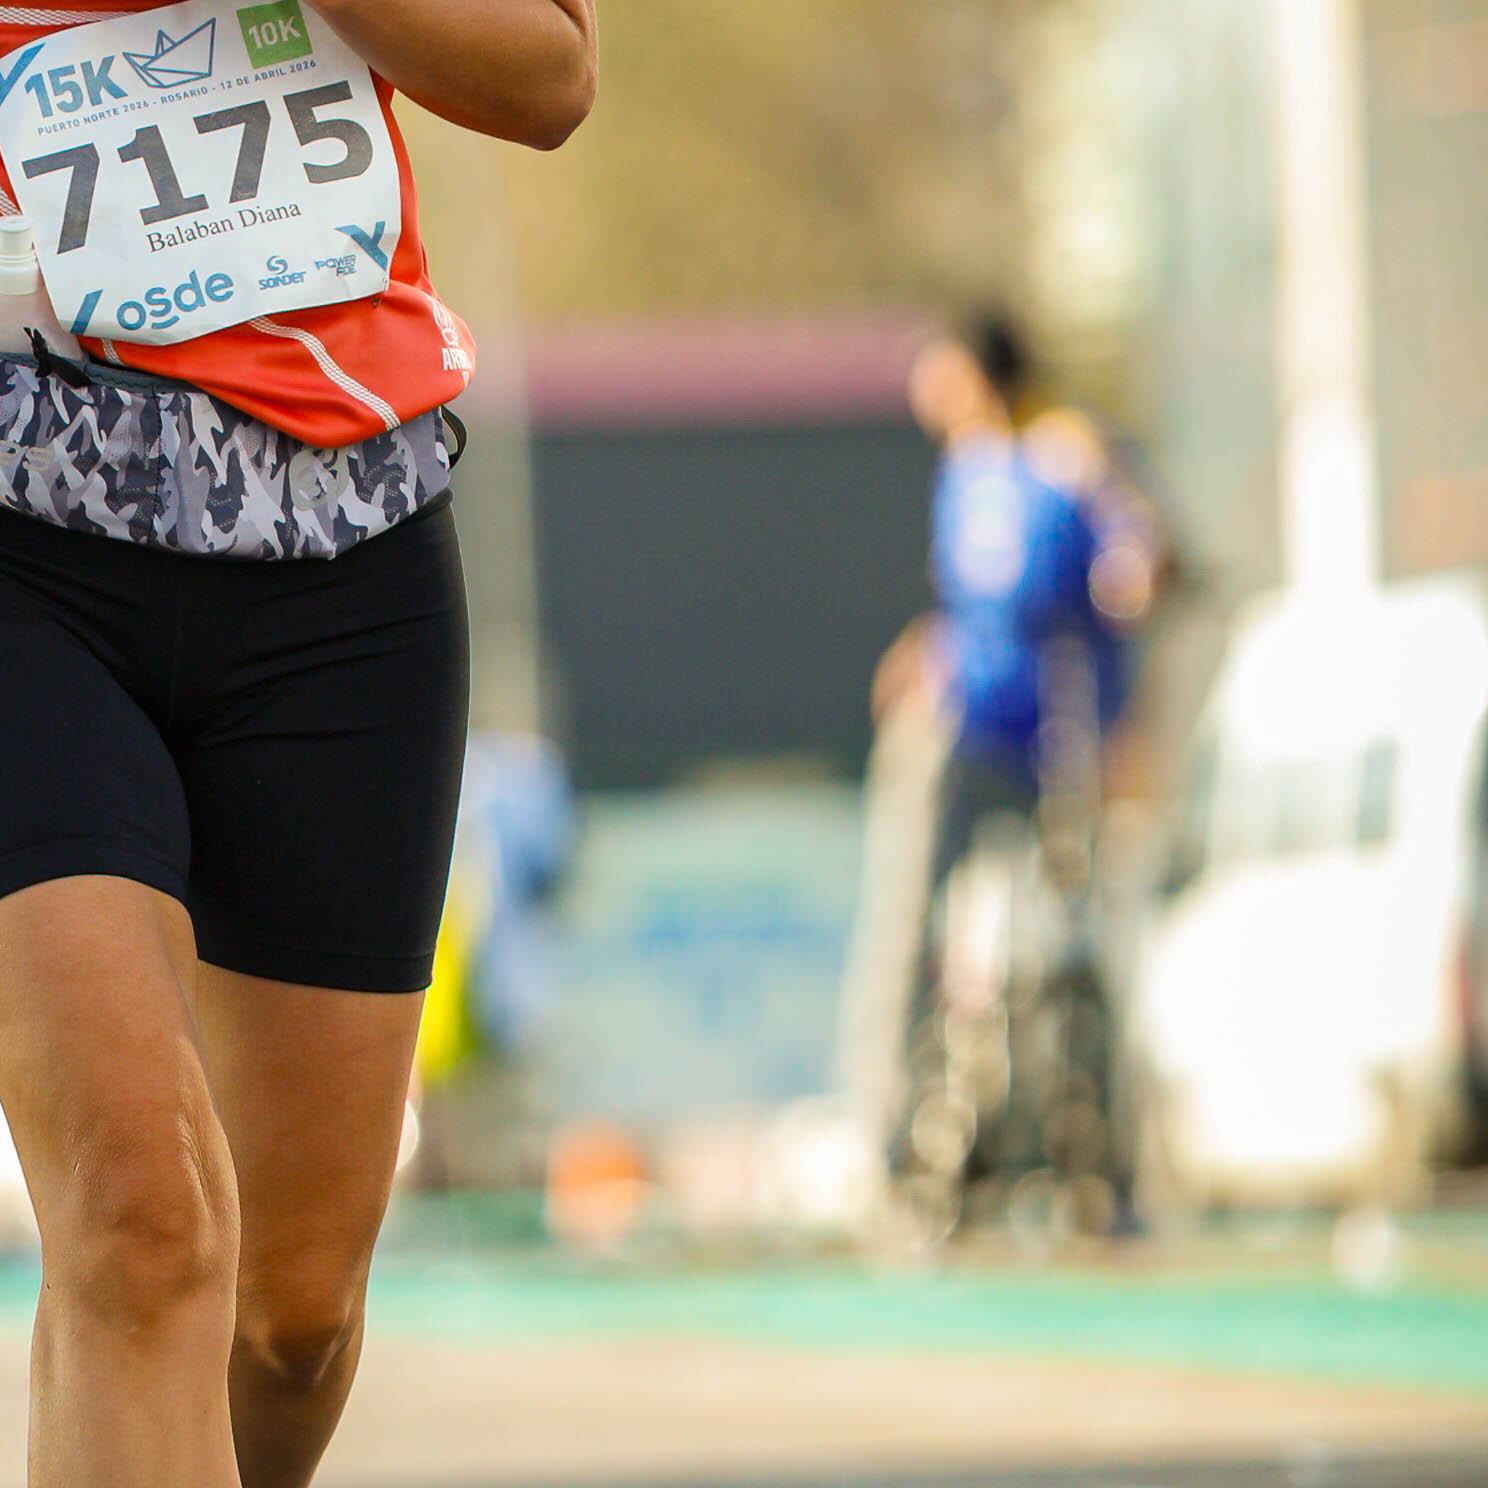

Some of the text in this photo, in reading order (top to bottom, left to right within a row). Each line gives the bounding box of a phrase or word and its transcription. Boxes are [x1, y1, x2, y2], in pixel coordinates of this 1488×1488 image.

[248, 15, 301, 49] 10K
[24, 55, 128, 118] 15K
[37, 118, 80, 136] PUERTO
[83, 107, 120, 124] NORTE
[122, 100, 150, 114] 2026
[160, 86, 209, 105] ROSARIO
[220, 80, 233, 90] 12
[236, 77, 250, 87] DE
[254, 68, 287, 83] ABRIL
[290, 59, 317, 74] 2026
[21, 79, 373, 255] 7175
[146, 202, 302, 253] Balaban Diana
[314, 254, 356, 271] POWER
[116, 269, 234, 331] osde
